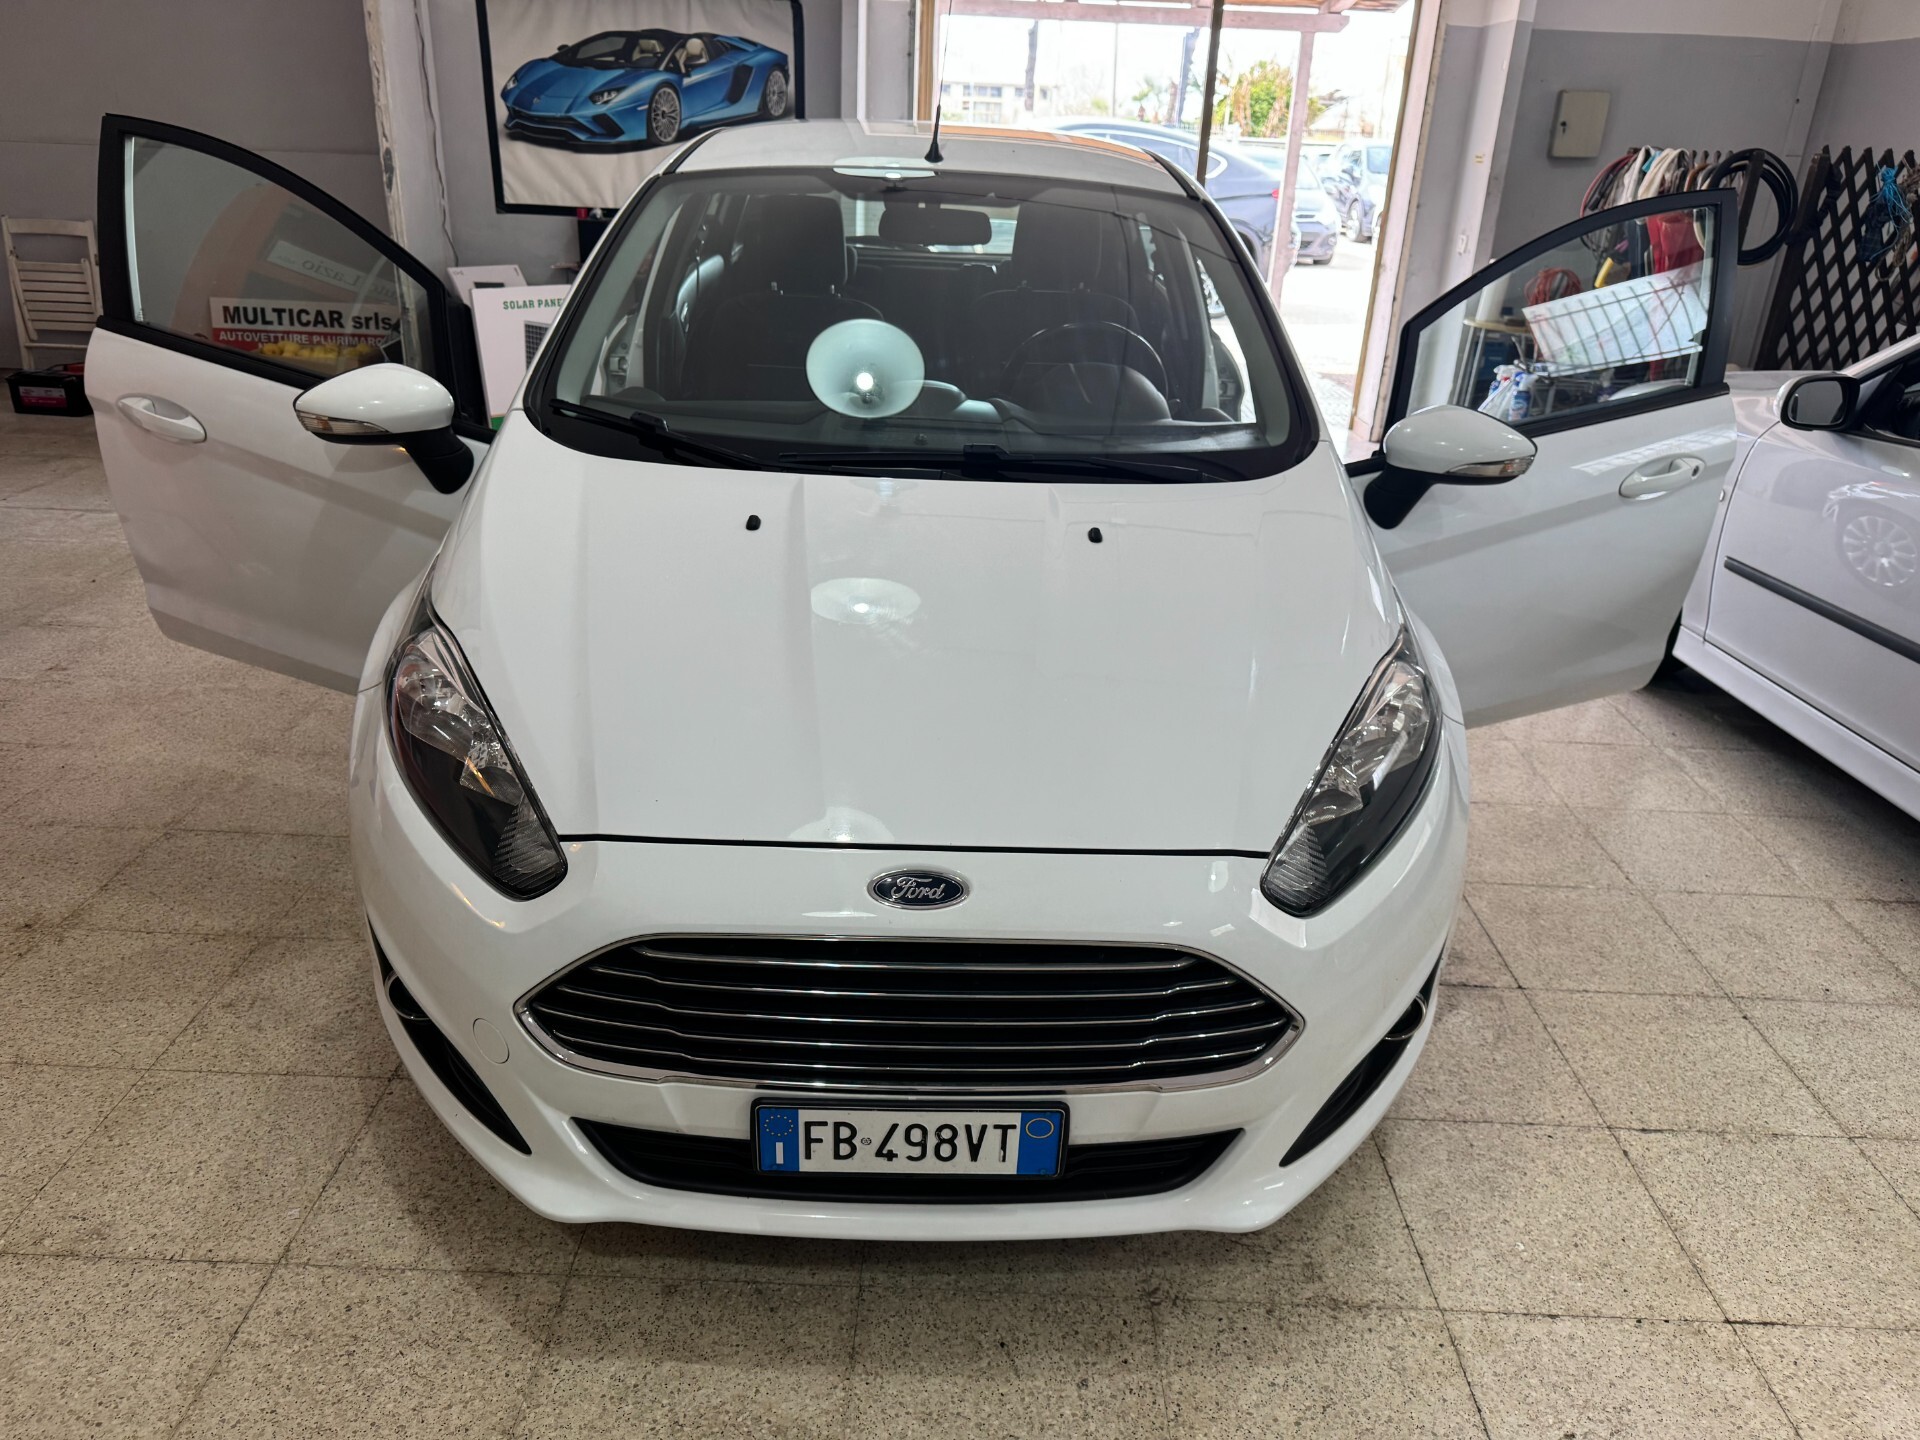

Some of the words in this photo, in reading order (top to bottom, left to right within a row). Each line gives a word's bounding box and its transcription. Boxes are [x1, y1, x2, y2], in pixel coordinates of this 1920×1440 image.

[503, 299, 535, 310] SOLAR
[538, 298, 563, 309] PANE
[222, 305, 345, 329] MULTICAR
[352, 312, 392, 331] srls
[219, 331, 309, 345] AUTOVETTURE
[890, 876, 946, 901] Ford
